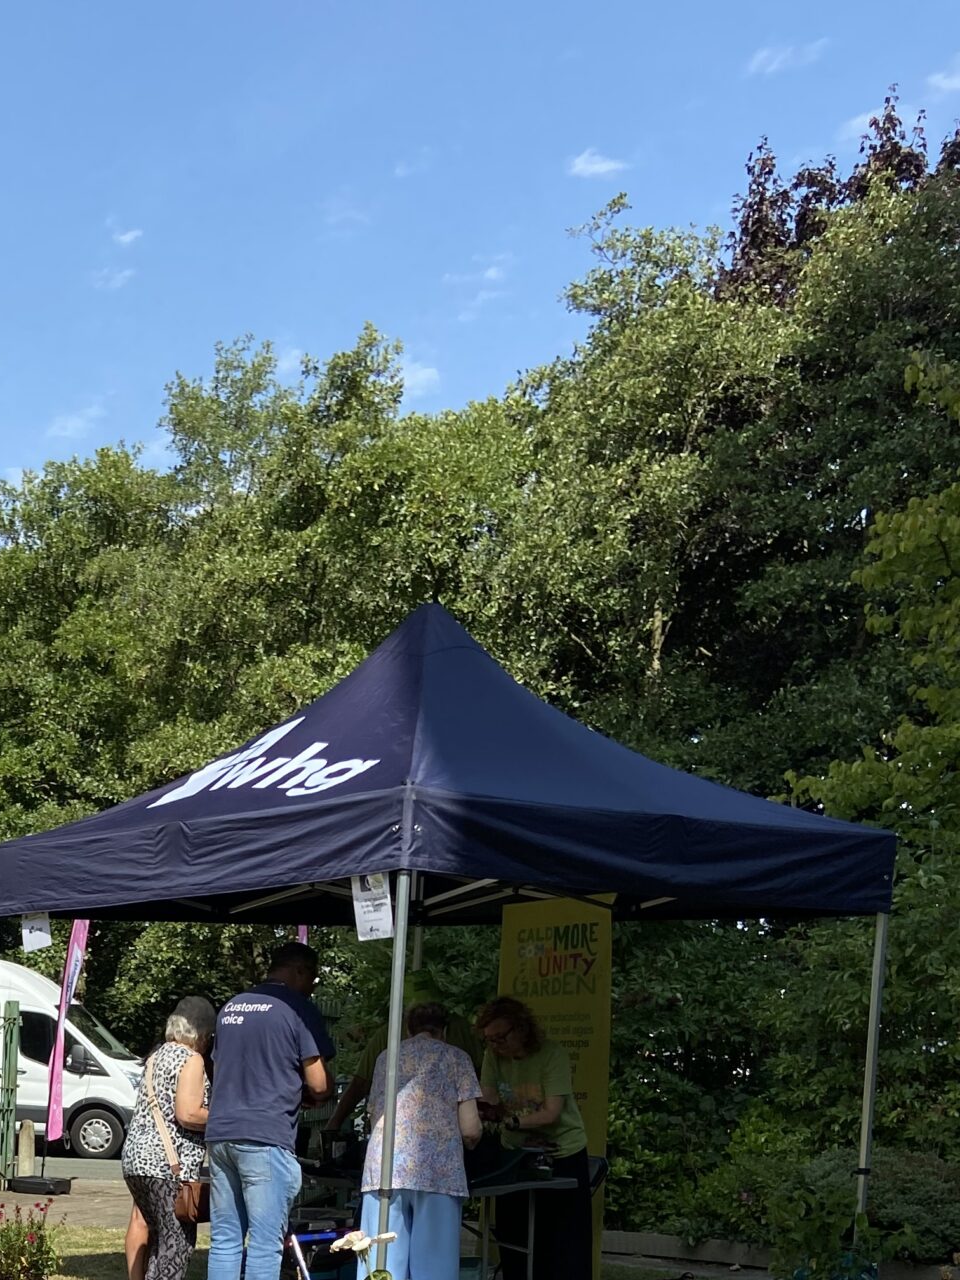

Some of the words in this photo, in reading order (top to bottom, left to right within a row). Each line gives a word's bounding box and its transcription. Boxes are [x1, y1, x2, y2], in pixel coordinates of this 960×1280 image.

[538, 952, 597, 977] UNITY
[512, 972, 597, 997] GARDEN
[224, 1002, 273, 1012] Customer
